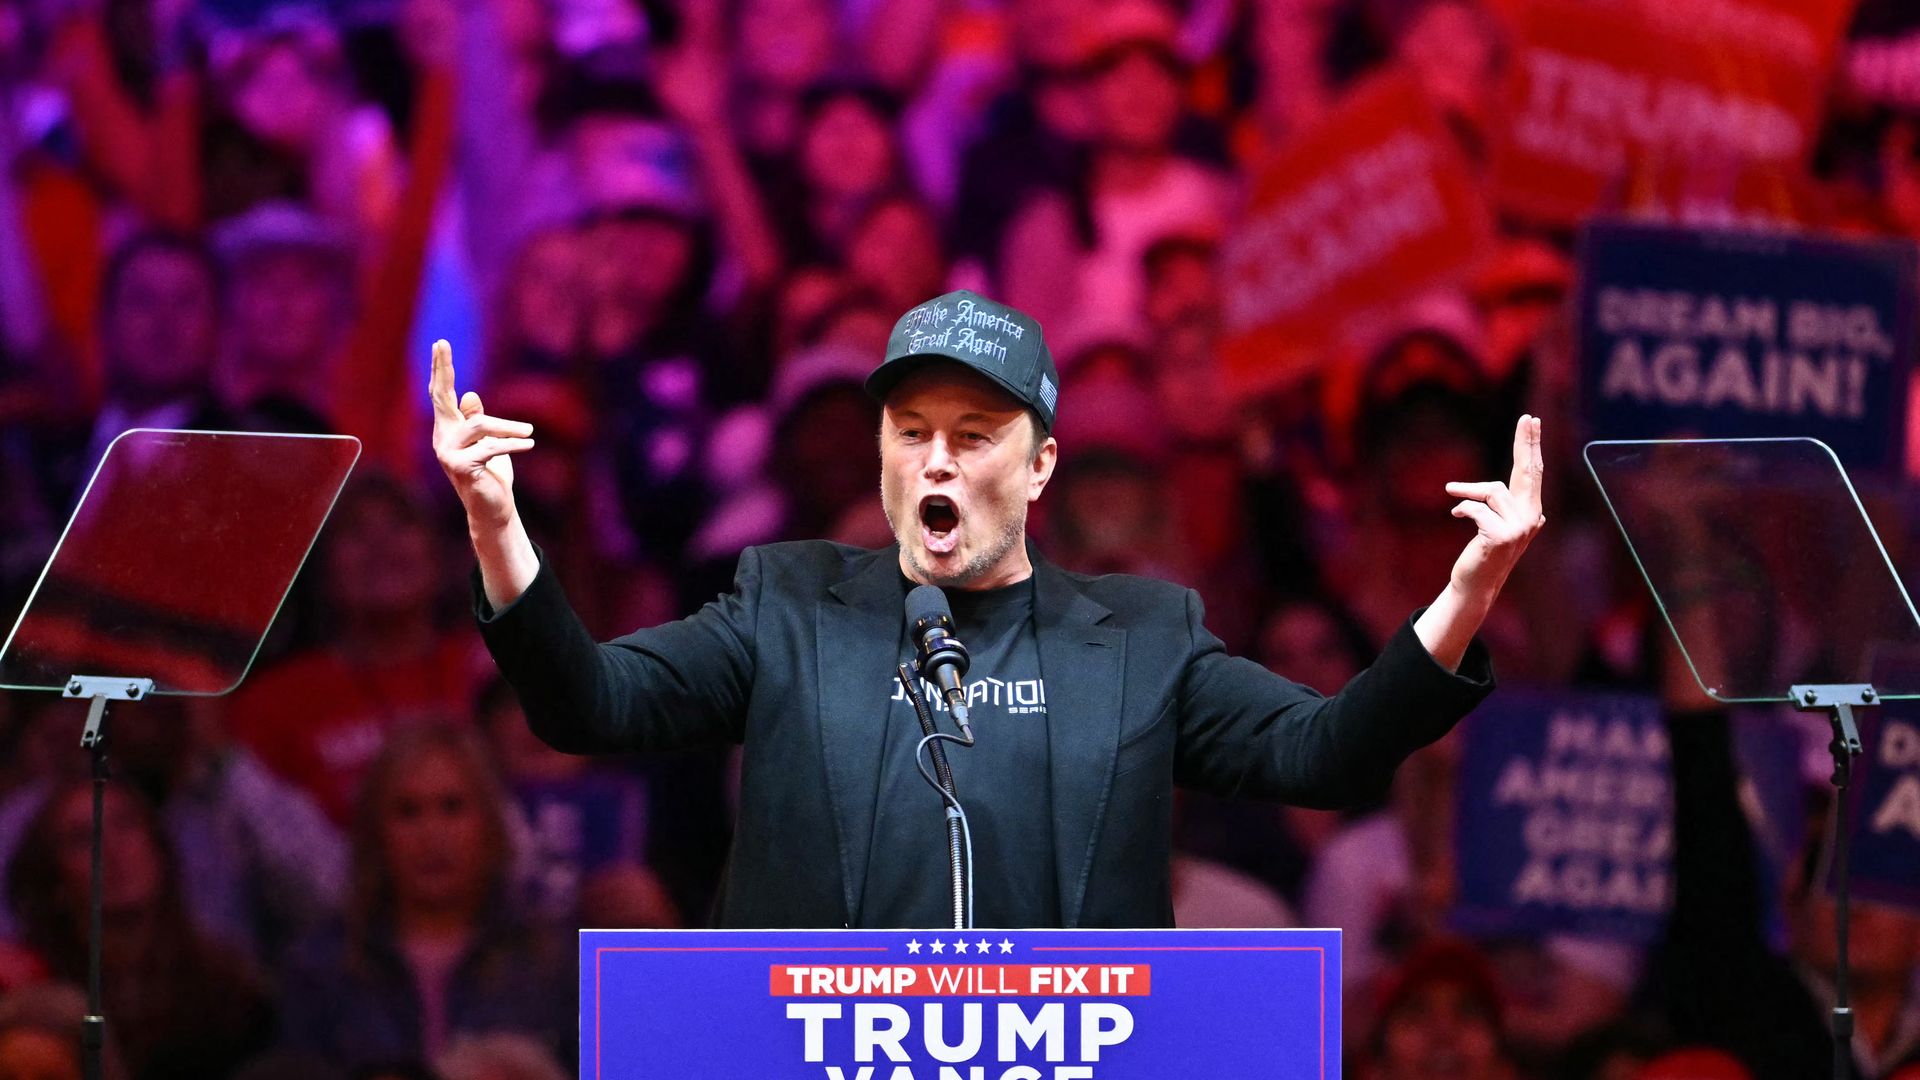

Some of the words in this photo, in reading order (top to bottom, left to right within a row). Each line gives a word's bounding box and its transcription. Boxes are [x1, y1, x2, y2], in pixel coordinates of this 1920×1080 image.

[904, 302, 948, 335] Make
[950, 300, 1025, 340] America
[906, 326, 952, 355] Great
[951, 328, 1007, 364] Again
[1602, 337, 1868, 418] AGAIN!
[786, 967, 917, 994] TRUMP
[927, 967, 1018, 994] WILL
[1030, 967, 1090, 994] FIX
[1101, 967, 1135, 994] IT
[786, 1003, 1134, 1063] TRUMP
